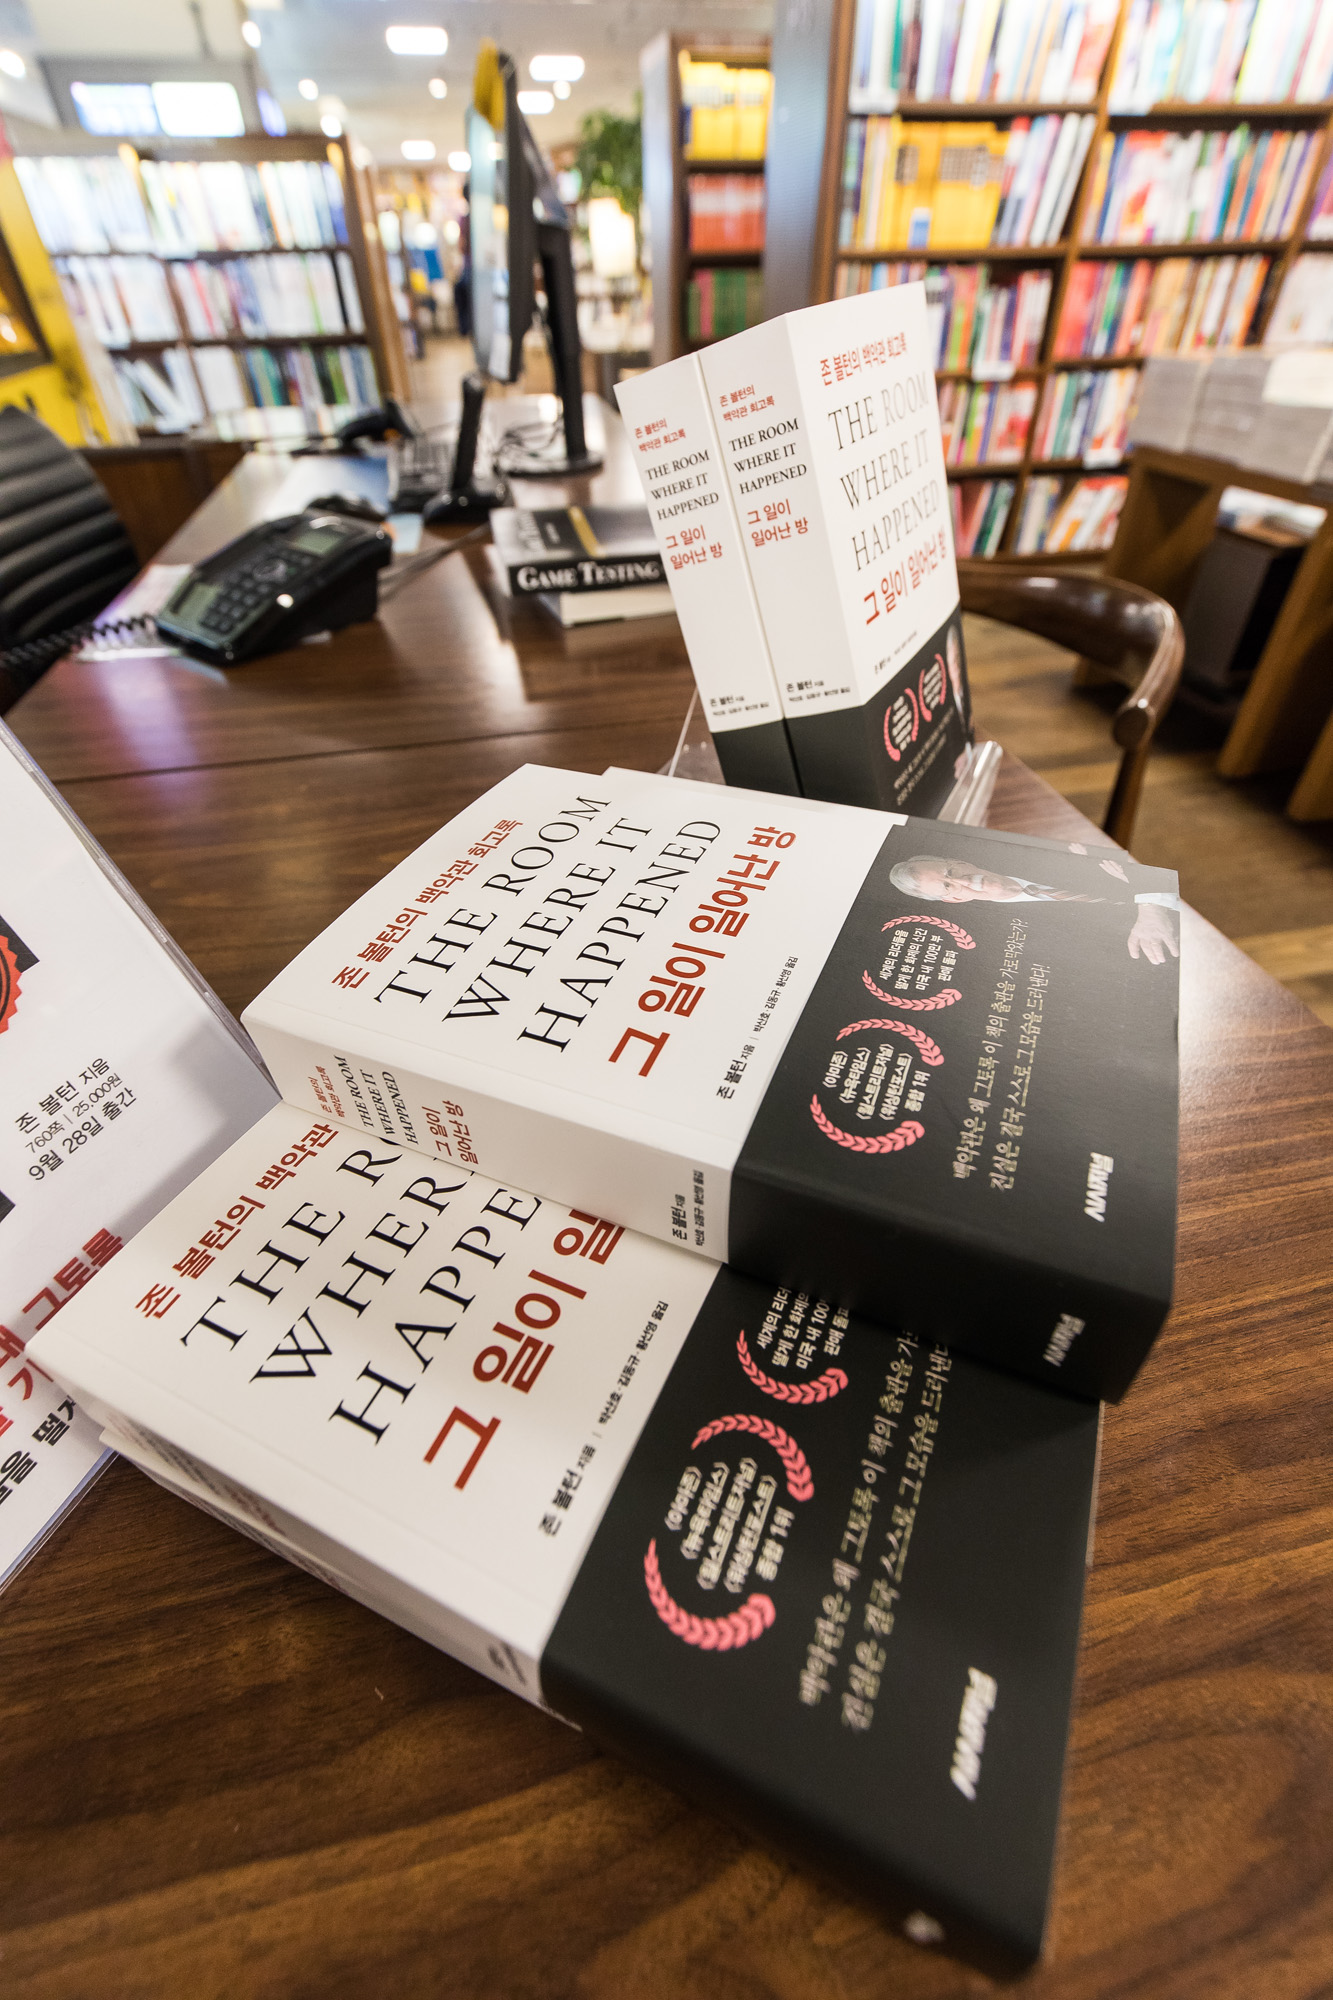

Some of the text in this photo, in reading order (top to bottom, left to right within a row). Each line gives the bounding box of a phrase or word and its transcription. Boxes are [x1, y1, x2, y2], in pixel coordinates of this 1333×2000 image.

[820, 358, 832, 386] 존
[833, 347, 862, 382] 볼턴의
[719, 384, 755, 407] 존 볼턴의
[722, 395, 775, 422] 백악관 회고록
[828, 371, 930, 450] THE ROOM
[634, 418, 667, 439] 존 볼턴의
[638, 428, 686, 453] 백악관 회고록
[729, 418, 799, 452] THE ROOM
[645, 449, 710, 481] THE ROOM
[733, 442, 797, 473] WHERE IT
[739, 463, 807, 495] HAPPENED
[840, 428, 928, 510] WHERE IT
[651, 472, 709, 501] WHERE IT
[656, 492, 720, 520] HAPPENED
[747, 498, 792, 525] 그 일이
[751, 517, 809, 547] 일어난 방
[852, 479, 940, 571] HAPPENED
[665, 525, 706, 550] 그 일이
[669, 541, 723, 570] 일어난 방
[517, 560, 660, 591] GAME TESTING
[864, 590, 880, 625] 그
[881, 561, 908, 613] 일이
[908, 533, 938, 589] 일어난
[331, 819, 523, 989] 존 볼턴의 백악관 회고록
[373, 795, 612, 1003] THE ROOM
[441, 817, 653, 1022] WHERE IT
[516, 820, 721, 1053] HAPPENED
[608, 826, 796, 1077] 그 일이 일어난 방
[879, 929, 909, 980] 세계의 리더들을
[894, 927, 928, 990] 떨게 한 화제의 신간
[915, 934, 944, 991] 미국 내 100만 부
[937, 949, 959, 982] 판매 돌파
[990, 980, 1016, 1014] 출판을
[981, 1040, 1004, 1055] 이
[985, 1014, 1009, 1039] 책의
[724, 1059, 748, 1084] 볼턴
[740, 1044, 755, 1060] 지음
[15, 1058, 110, 1134] 존 볼턴 지음
[307, 1076, 333, 1114] 존 볼턴의
[315, 1065, 345, 1118] 백악관 회고록
[334, 1054, 375, 1129] THE ROOM
[716, 1085, 735, 1100] 존
[904, 1070, 931, 1112] 종합 1위
[973, 1056, 1001, 1098] 그토록
[988, 963, 1051, 1192] 진실은 결국 스스로 그 모습을 드러낸다!
[25, 1072, 123, 1153] 760쪽 25,000원
[359, 1068, 396, 1136] WHERE IT
[382, 1071, 419, 1145] HAPPENED
[967, 1097, 992, 1114] 왜
[28, 1087, 137, 1181] 9월 28일 출간
[421, 1106, 452, 1157] 그 일이
[442, 1100, 479, 1165] 일어난 방
[952, 1116, 987, 1179] 백악관은
[134, 1123, 339, 1319] 존 볼턴의 백악관
[670, 1205, 687, 1229] 볼턴
[672, 1227, 688, 1241] 존
[21, 1227, 124, 1331] 그토록
[180, 1202, 346, 1352] THE
[756, 1311, 782, 1349] 세계의
[771, 1324, 800, 1368] 떨게 한
[795, 1326, 822, 1369] 미국 내
[823, 1328, 845, 1356] 판매
[422, 1405, 501, 1492] 그
[472, 1269, 587, 1395] 일이
[538, 1512, 563, 1538] 존
[551, 1469, 583, 1511] 볼턴
[799, 1358, 914, 1707] 백악관은 왜 그토록 이 책의 출판을
[841, 1412, 939, 1735] 진실은 결국 스스로 그 모습을
